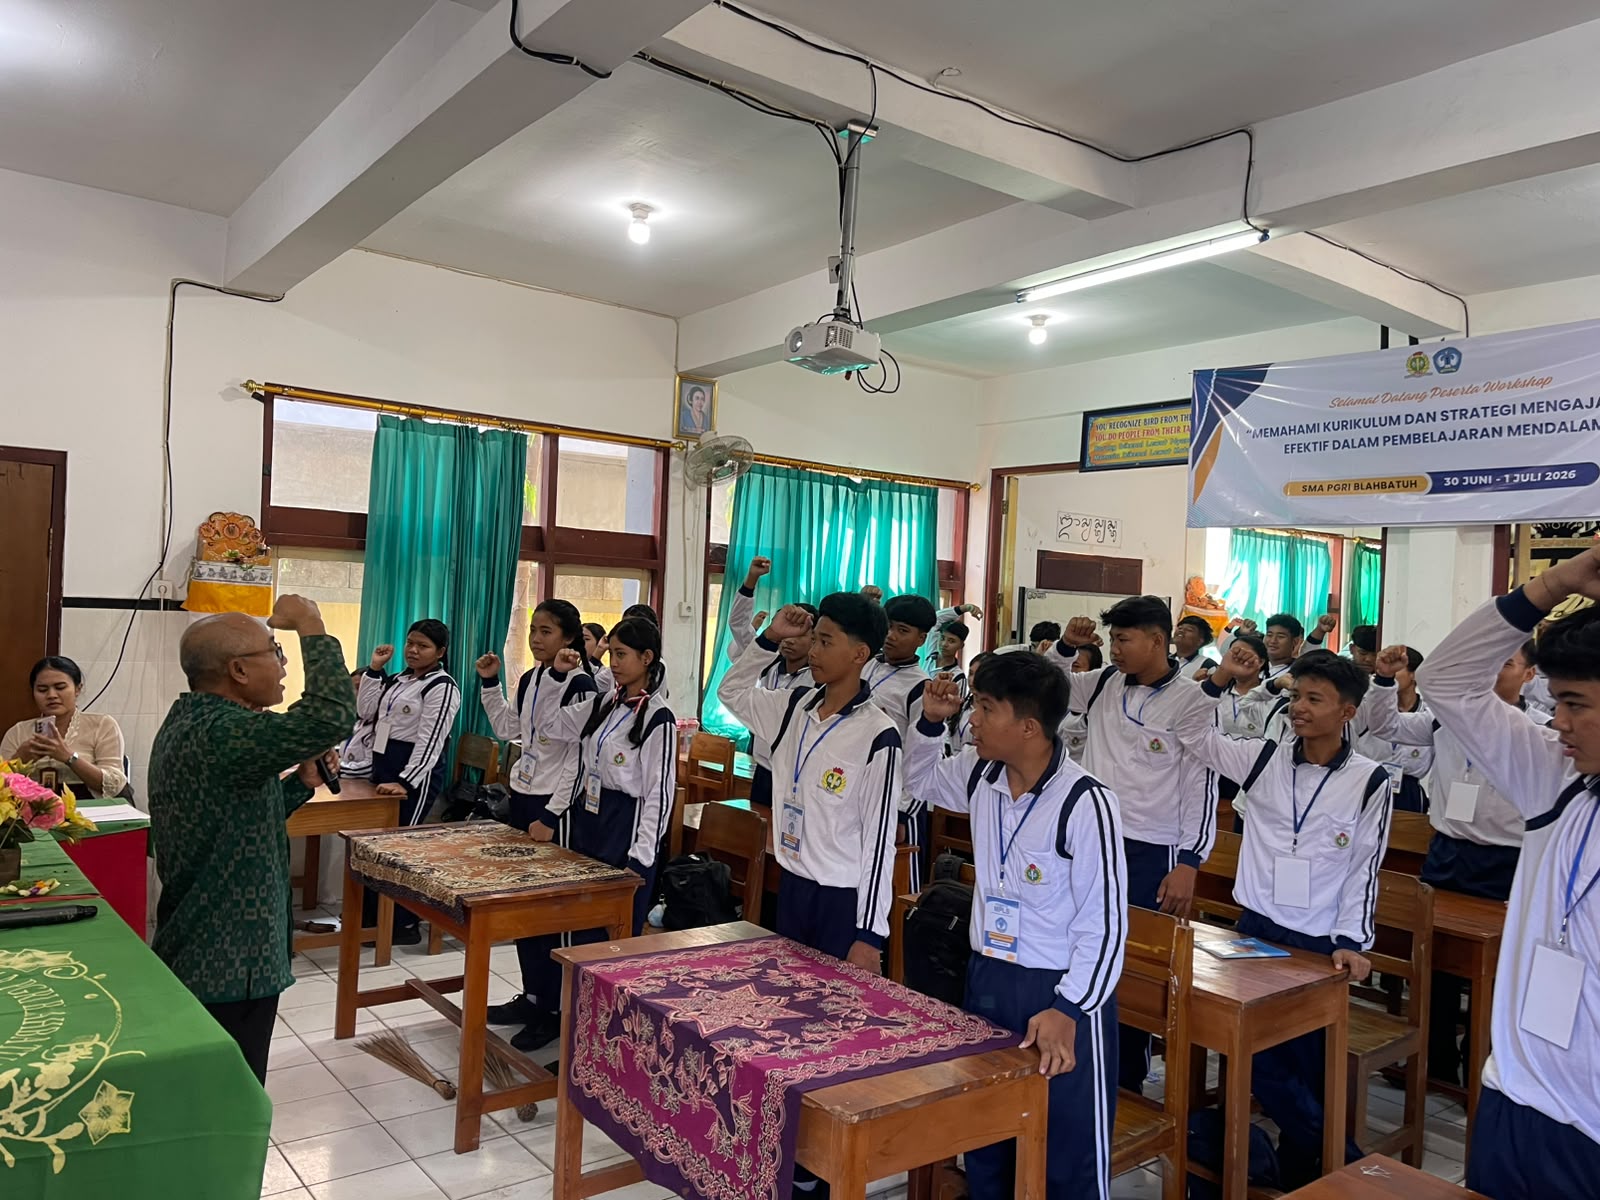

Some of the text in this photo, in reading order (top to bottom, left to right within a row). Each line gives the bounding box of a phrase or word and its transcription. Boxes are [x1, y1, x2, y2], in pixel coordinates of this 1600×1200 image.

[1329, 376, 1553, 408] Selamat Datang Peserta Workshop
[1109, 420, 1141, 430] RECOGNIZE
[1144, 417, 1159, 426] BIRD
[1160, 415, 1178, 424] FROM
[1323, 415, 1401, 432] KURIKULUM
[1405, 411, 1437, 425] DAN
[1441, 404, 1516, 421] STRATEGI
[1118, 430, 1140, 439] PEOPLE
[1162, 426, 1181, 435] THEIR
[1284, 440, 1330, 454] EFEKTIF
[1332, 436, 1379, 450] DALAM
[1383, 426, 1503, 446] PEMBELAJARAN
[1444, 477, 1459, 486] 30
[1463, 475, 1492, 485] JUNI
[1504, 474, 1509, 483] 1
[1513, 473, 1541, 483] JULI
[1545, 470, 1577, 480] 2026
[1301, 480, 1417, 493] SMA PGRI BLAHBATUH
